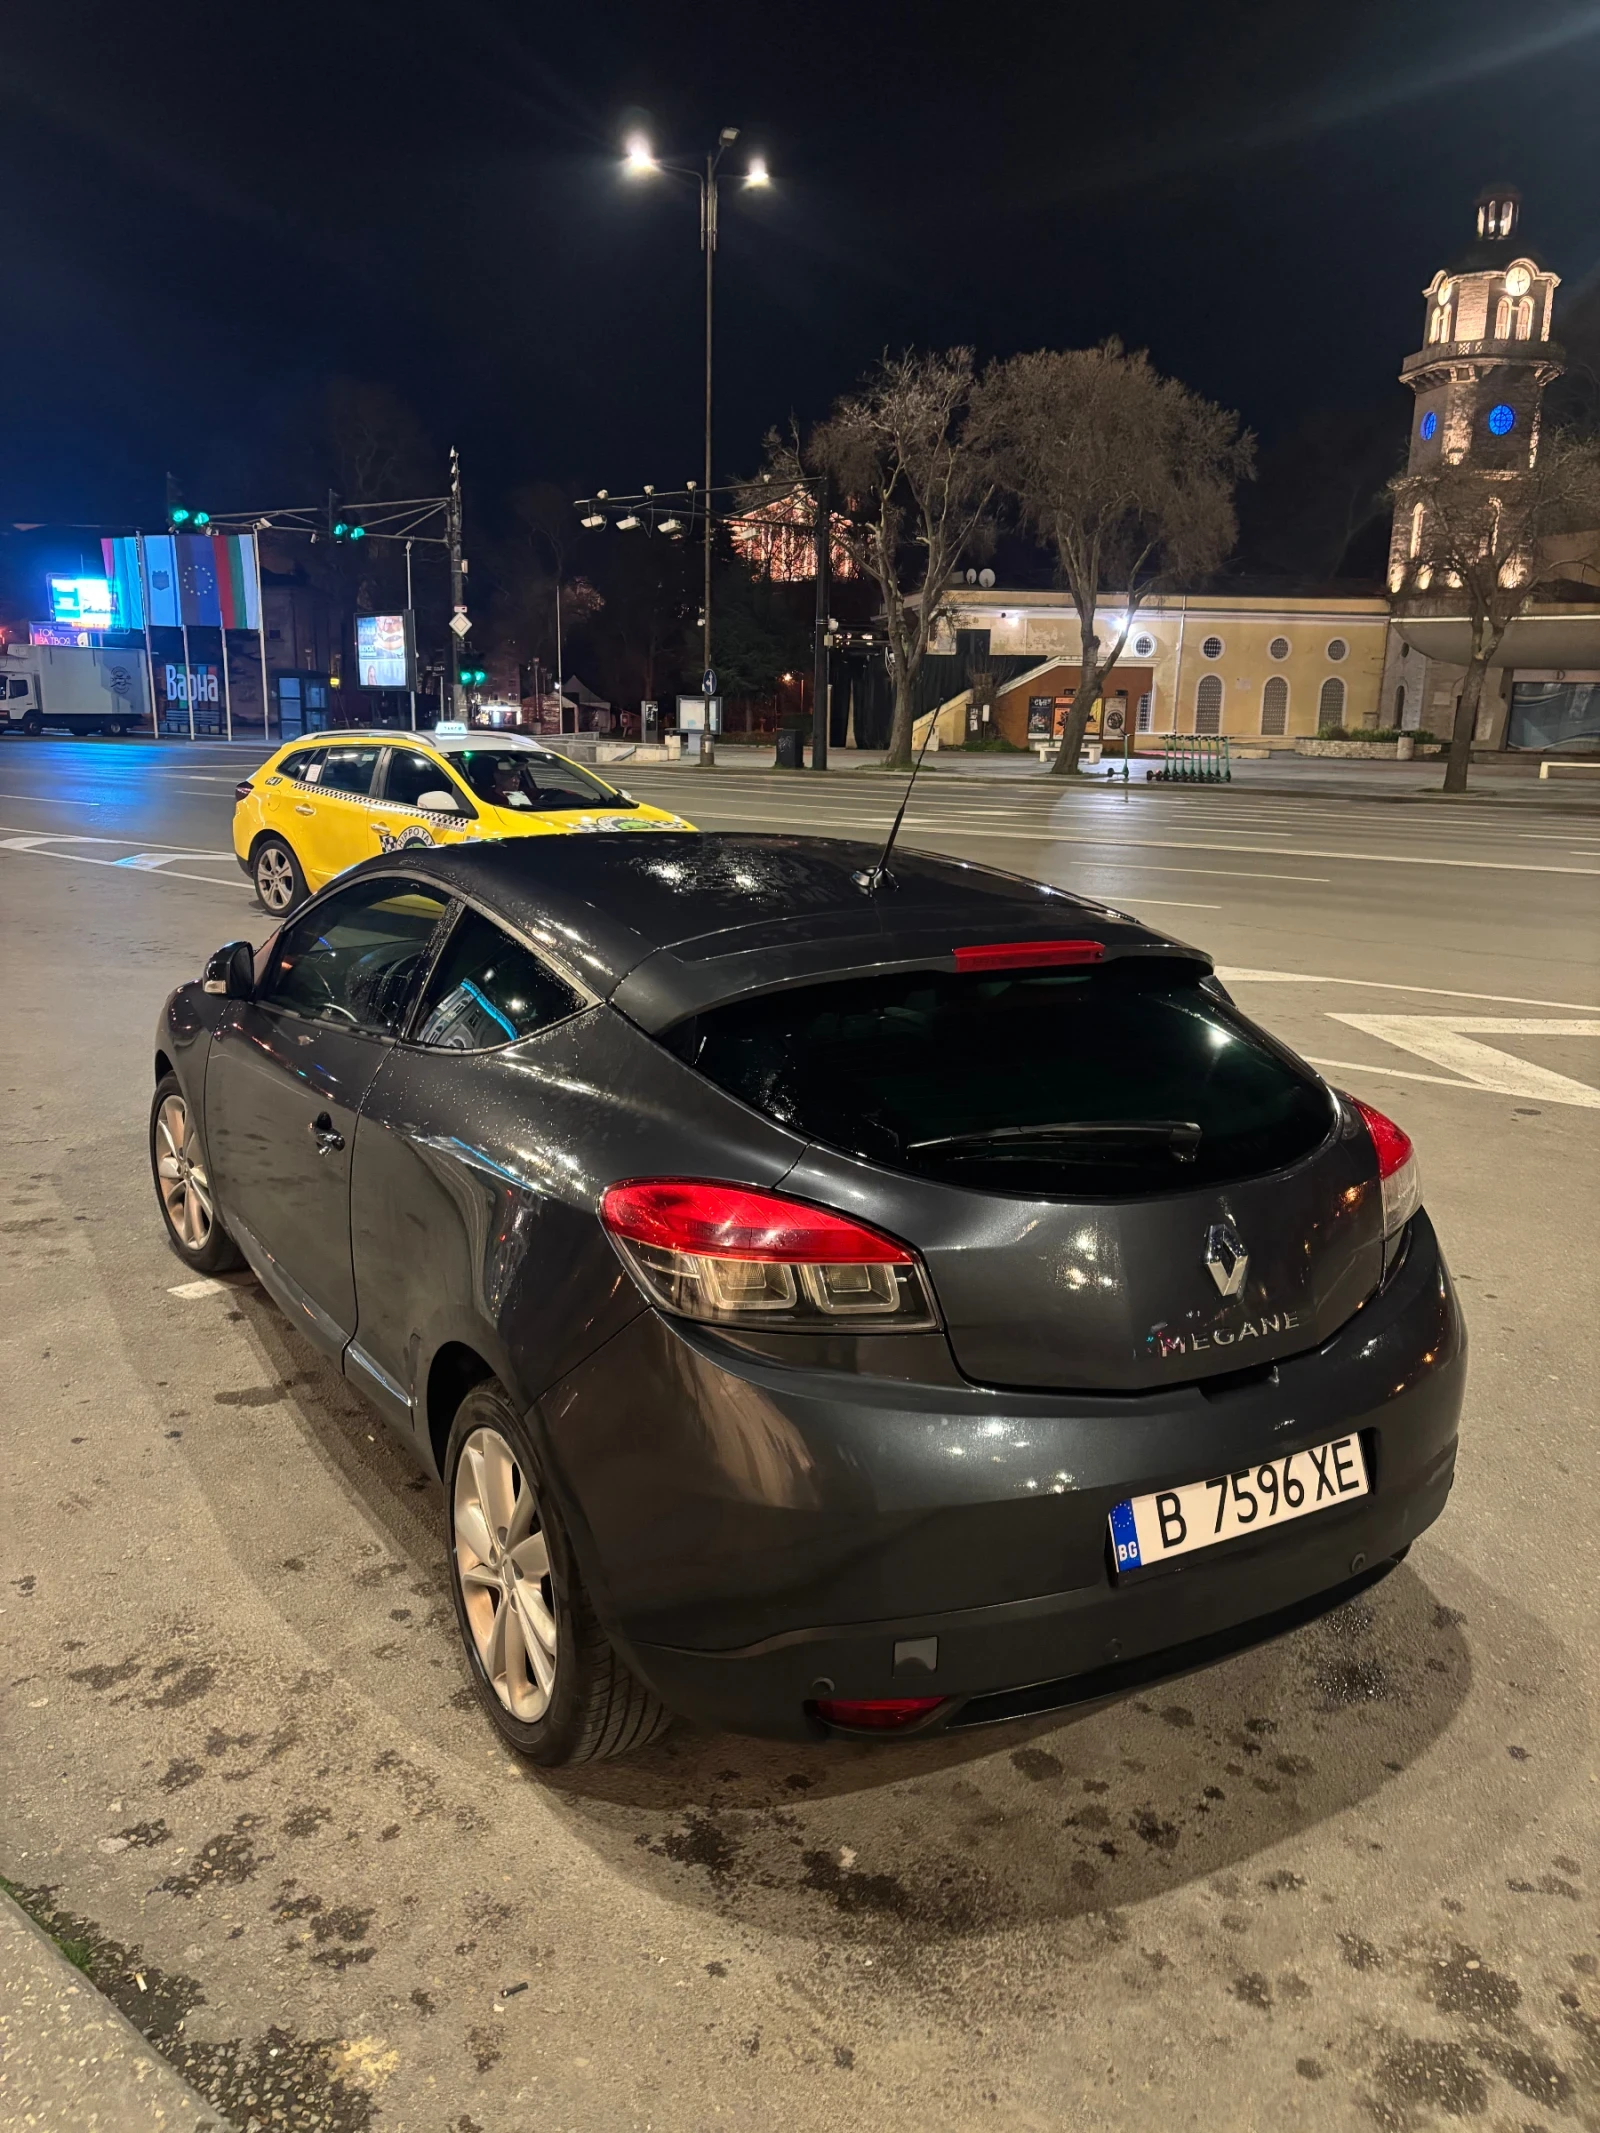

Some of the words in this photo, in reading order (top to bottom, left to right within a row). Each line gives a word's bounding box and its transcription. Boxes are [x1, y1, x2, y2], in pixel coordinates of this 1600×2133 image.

[38, 628, 54, 636] ТОК
[39, 637, 48, 645] ЗА
[50, 637, 70, 646] ТВОЯ
[165, 664, 219, 702] Варна
[398, 827, 420, 849] HIPPO
[421, 830, 434, 847] TAX
[1159, 1311, 1300, 1358] MEGANE
[1156, 1491, 1188, 1550] B
[1204, 1456, 1306, 1535] 7596
[1308, 1438, 1360, 1502] XE
[1117, 1540, 1138, 1562] BG
